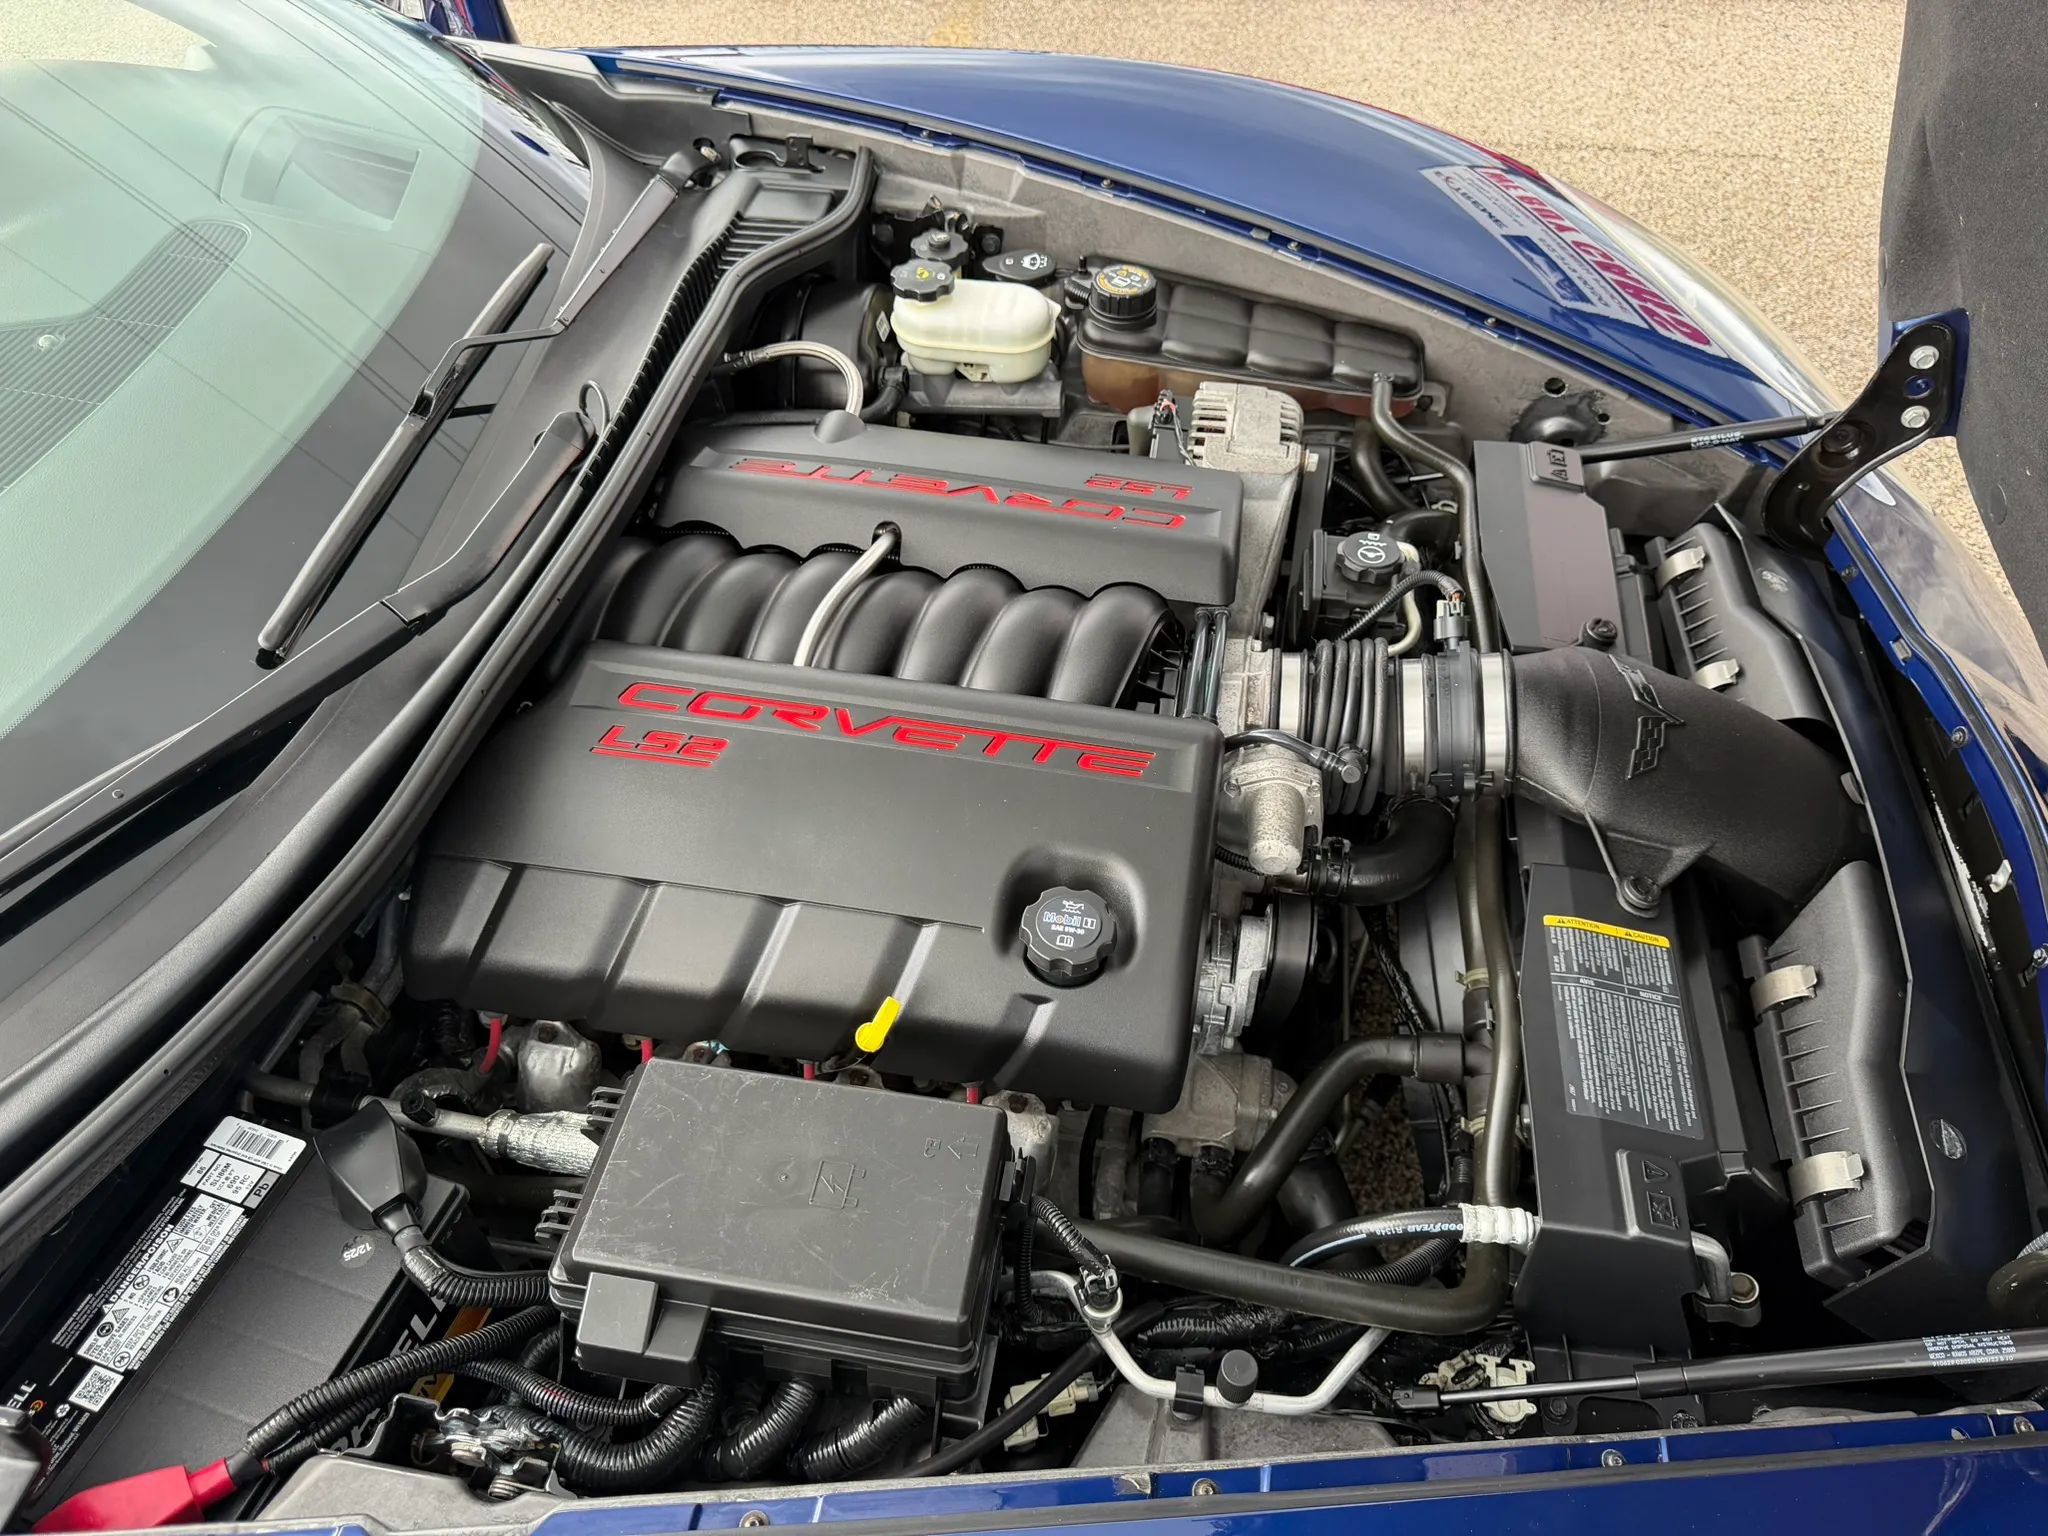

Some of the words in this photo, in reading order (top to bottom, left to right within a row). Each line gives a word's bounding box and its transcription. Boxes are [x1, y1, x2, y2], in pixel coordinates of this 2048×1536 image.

[729, 458, 1186, 529] CORVETTE
[1084, 474, 1194, 500] LS2
[617, 681, 1156, 777] CORVETTE
[592, 725, 731, 766] LS2
[1043, 911, 1082, 927] Mobil
[1567, 918, 1600, 930] ATTENTION
[1632, 931, 1660, 943] CAUTION
[1579, 977, 1596, 987] AVIS
[1639, 990, 1663, 1003] NOTICE
[195, 1165, 206, 1174] 86
[201, 1172, 214, 1185] PART
[225, 1174, 241, 1189] 690
[231, 1185, 242, 1194] 95
[238, 1174, 251, 1185] RC
[252, 1181, 271, 1197] Pb
[1407, 1222, 1462, 1233] OODYEAR
[108, 1223, 175, 1302] DANGER/POISON
[7, 1380, 37, 1408] ELL
